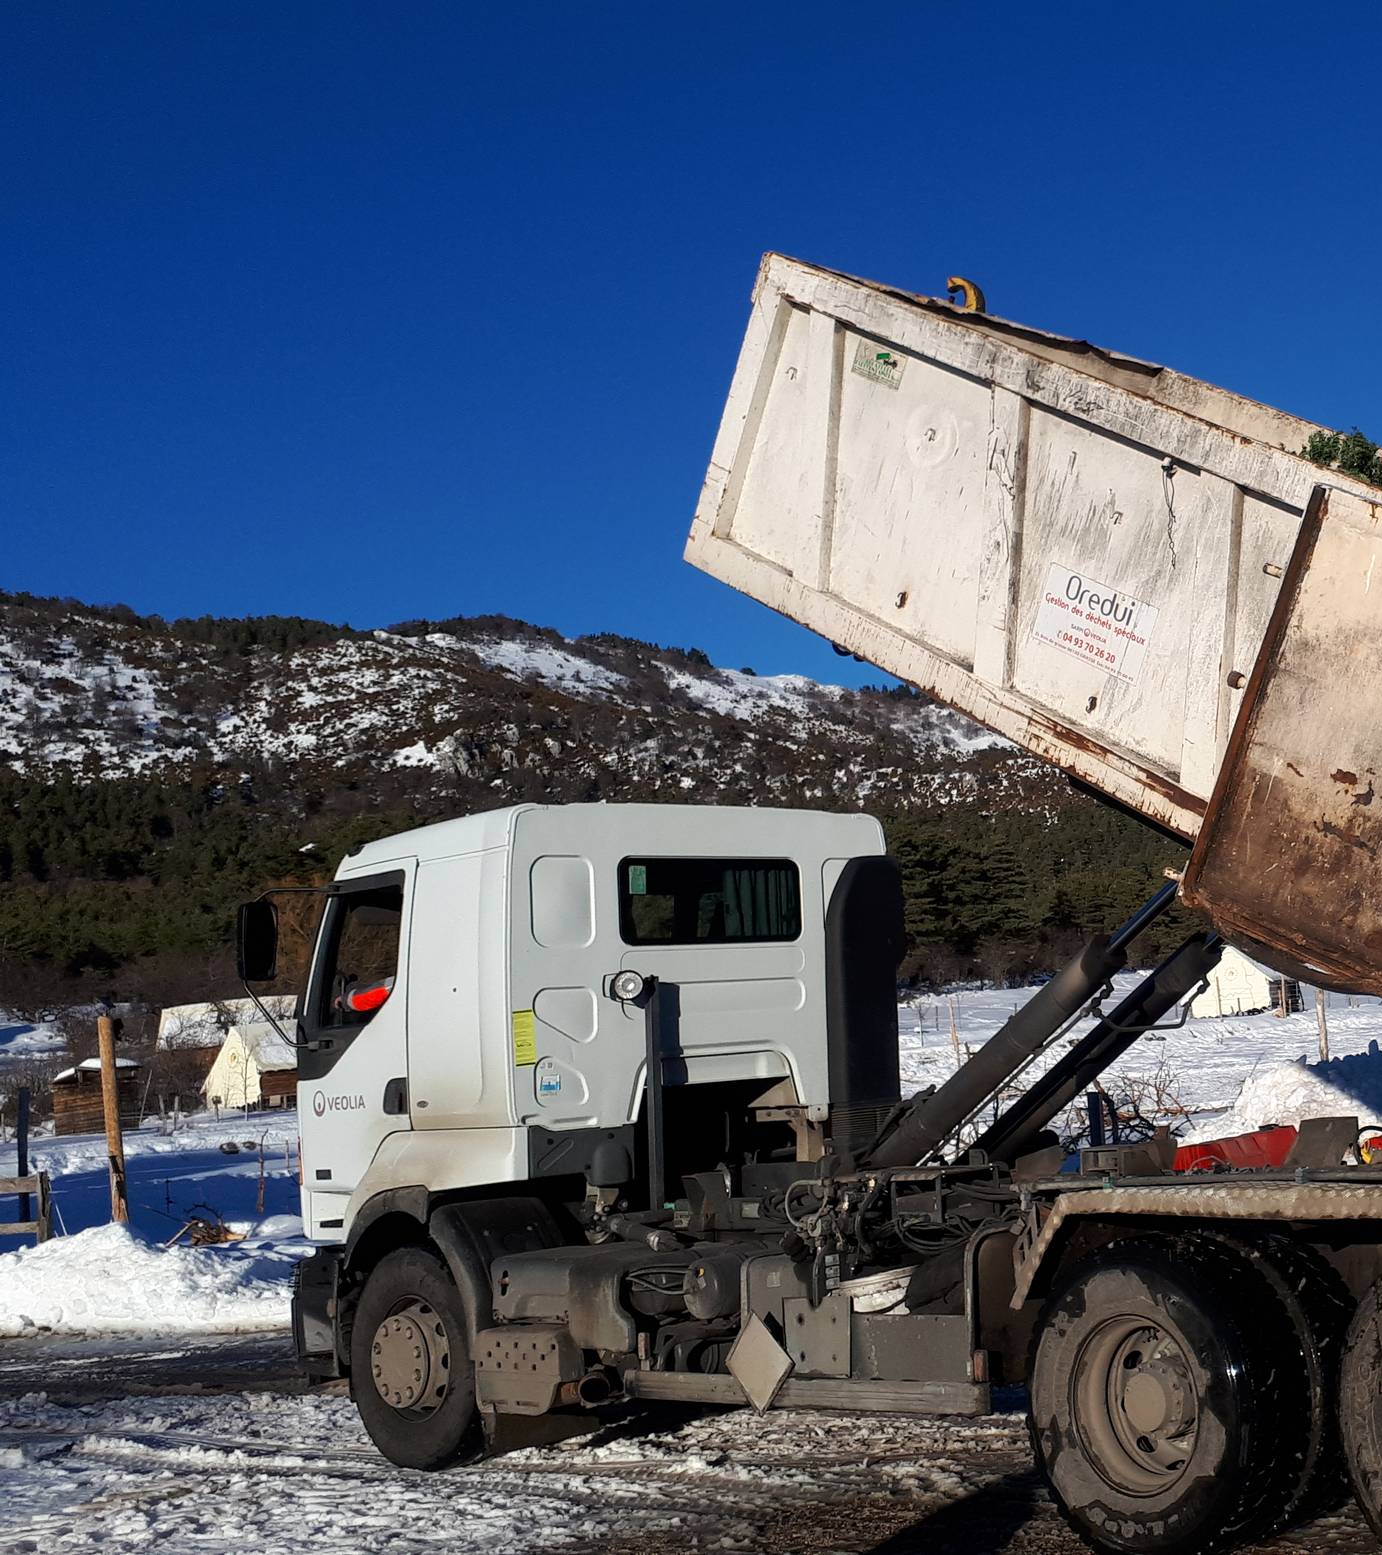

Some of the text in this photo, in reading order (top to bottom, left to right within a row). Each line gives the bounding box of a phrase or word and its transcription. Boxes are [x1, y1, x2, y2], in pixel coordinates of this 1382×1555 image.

[1045, 592, 1146, 645] Gestion des déchets spéciaux
[1066, 575, 1136, 626] Oredui
[1063, 632, 1073, 643] 04
[1073, 637, 1083, 648] 93
[1084, 642, 1094, 653] 70
[1094, 647, 1104, 658] 26
[1105, 652, 1115, 663] 20
[327, 1095, 366, 1111] VEOLIA
